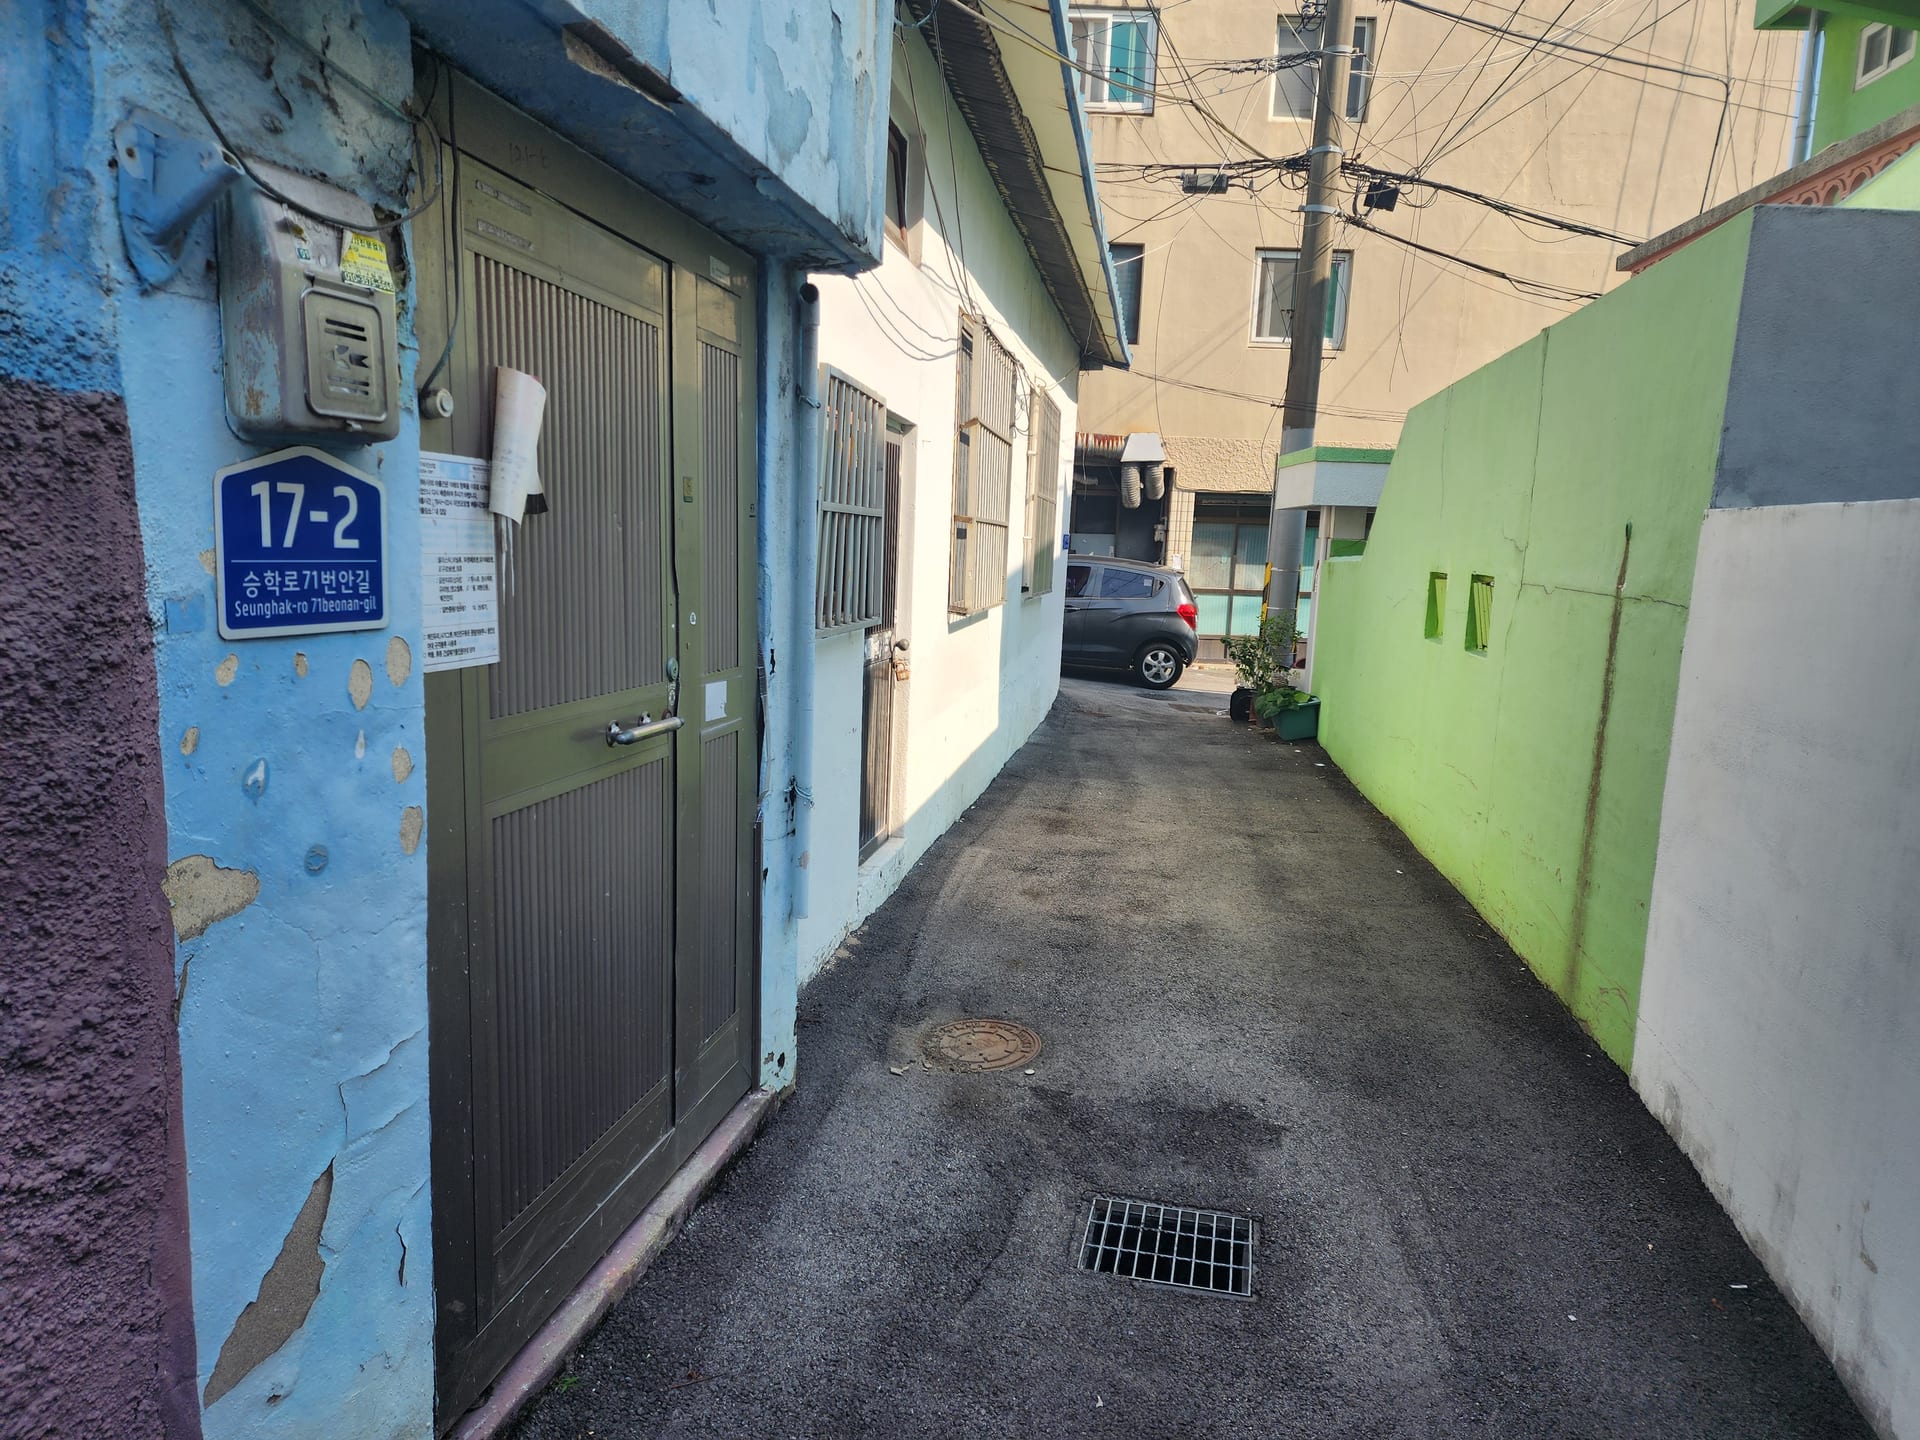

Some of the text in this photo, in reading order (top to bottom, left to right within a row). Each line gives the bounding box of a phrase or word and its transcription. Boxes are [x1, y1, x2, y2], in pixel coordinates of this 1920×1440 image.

[251, 481, 360, 549] 17-2
[242, 570, 371, 598] 승학로71번안길
[235, 595, 377, 618] Seunghak-ro 71beonan-gil
